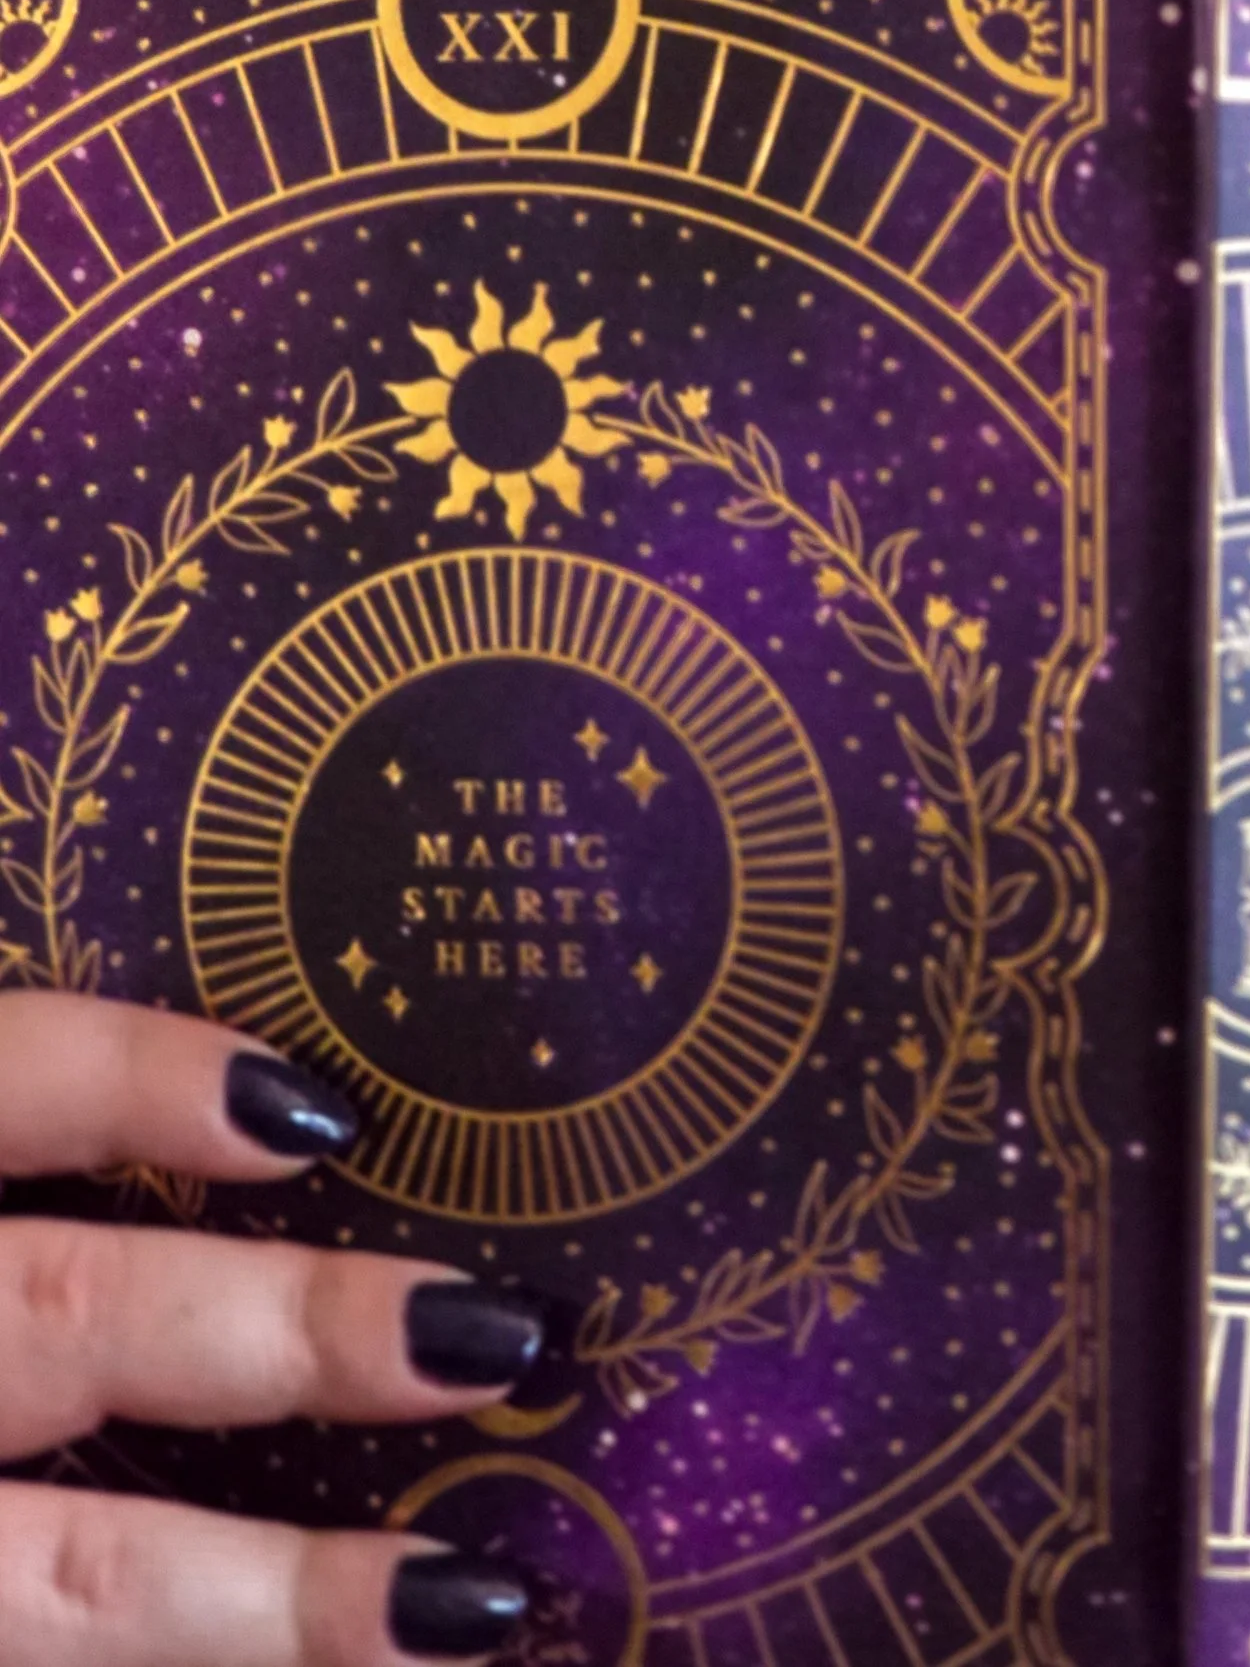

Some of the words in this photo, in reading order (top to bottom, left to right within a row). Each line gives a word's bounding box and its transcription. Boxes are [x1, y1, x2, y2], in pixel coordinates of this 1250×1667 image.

[436, 11, 571, 62] XXI
[453, 780, 567, 816] THE
[415, 832, 608, 870] MAGIC
[402, 887, 621, 924] STARTS
[435, 940, 587, 978] HERE
